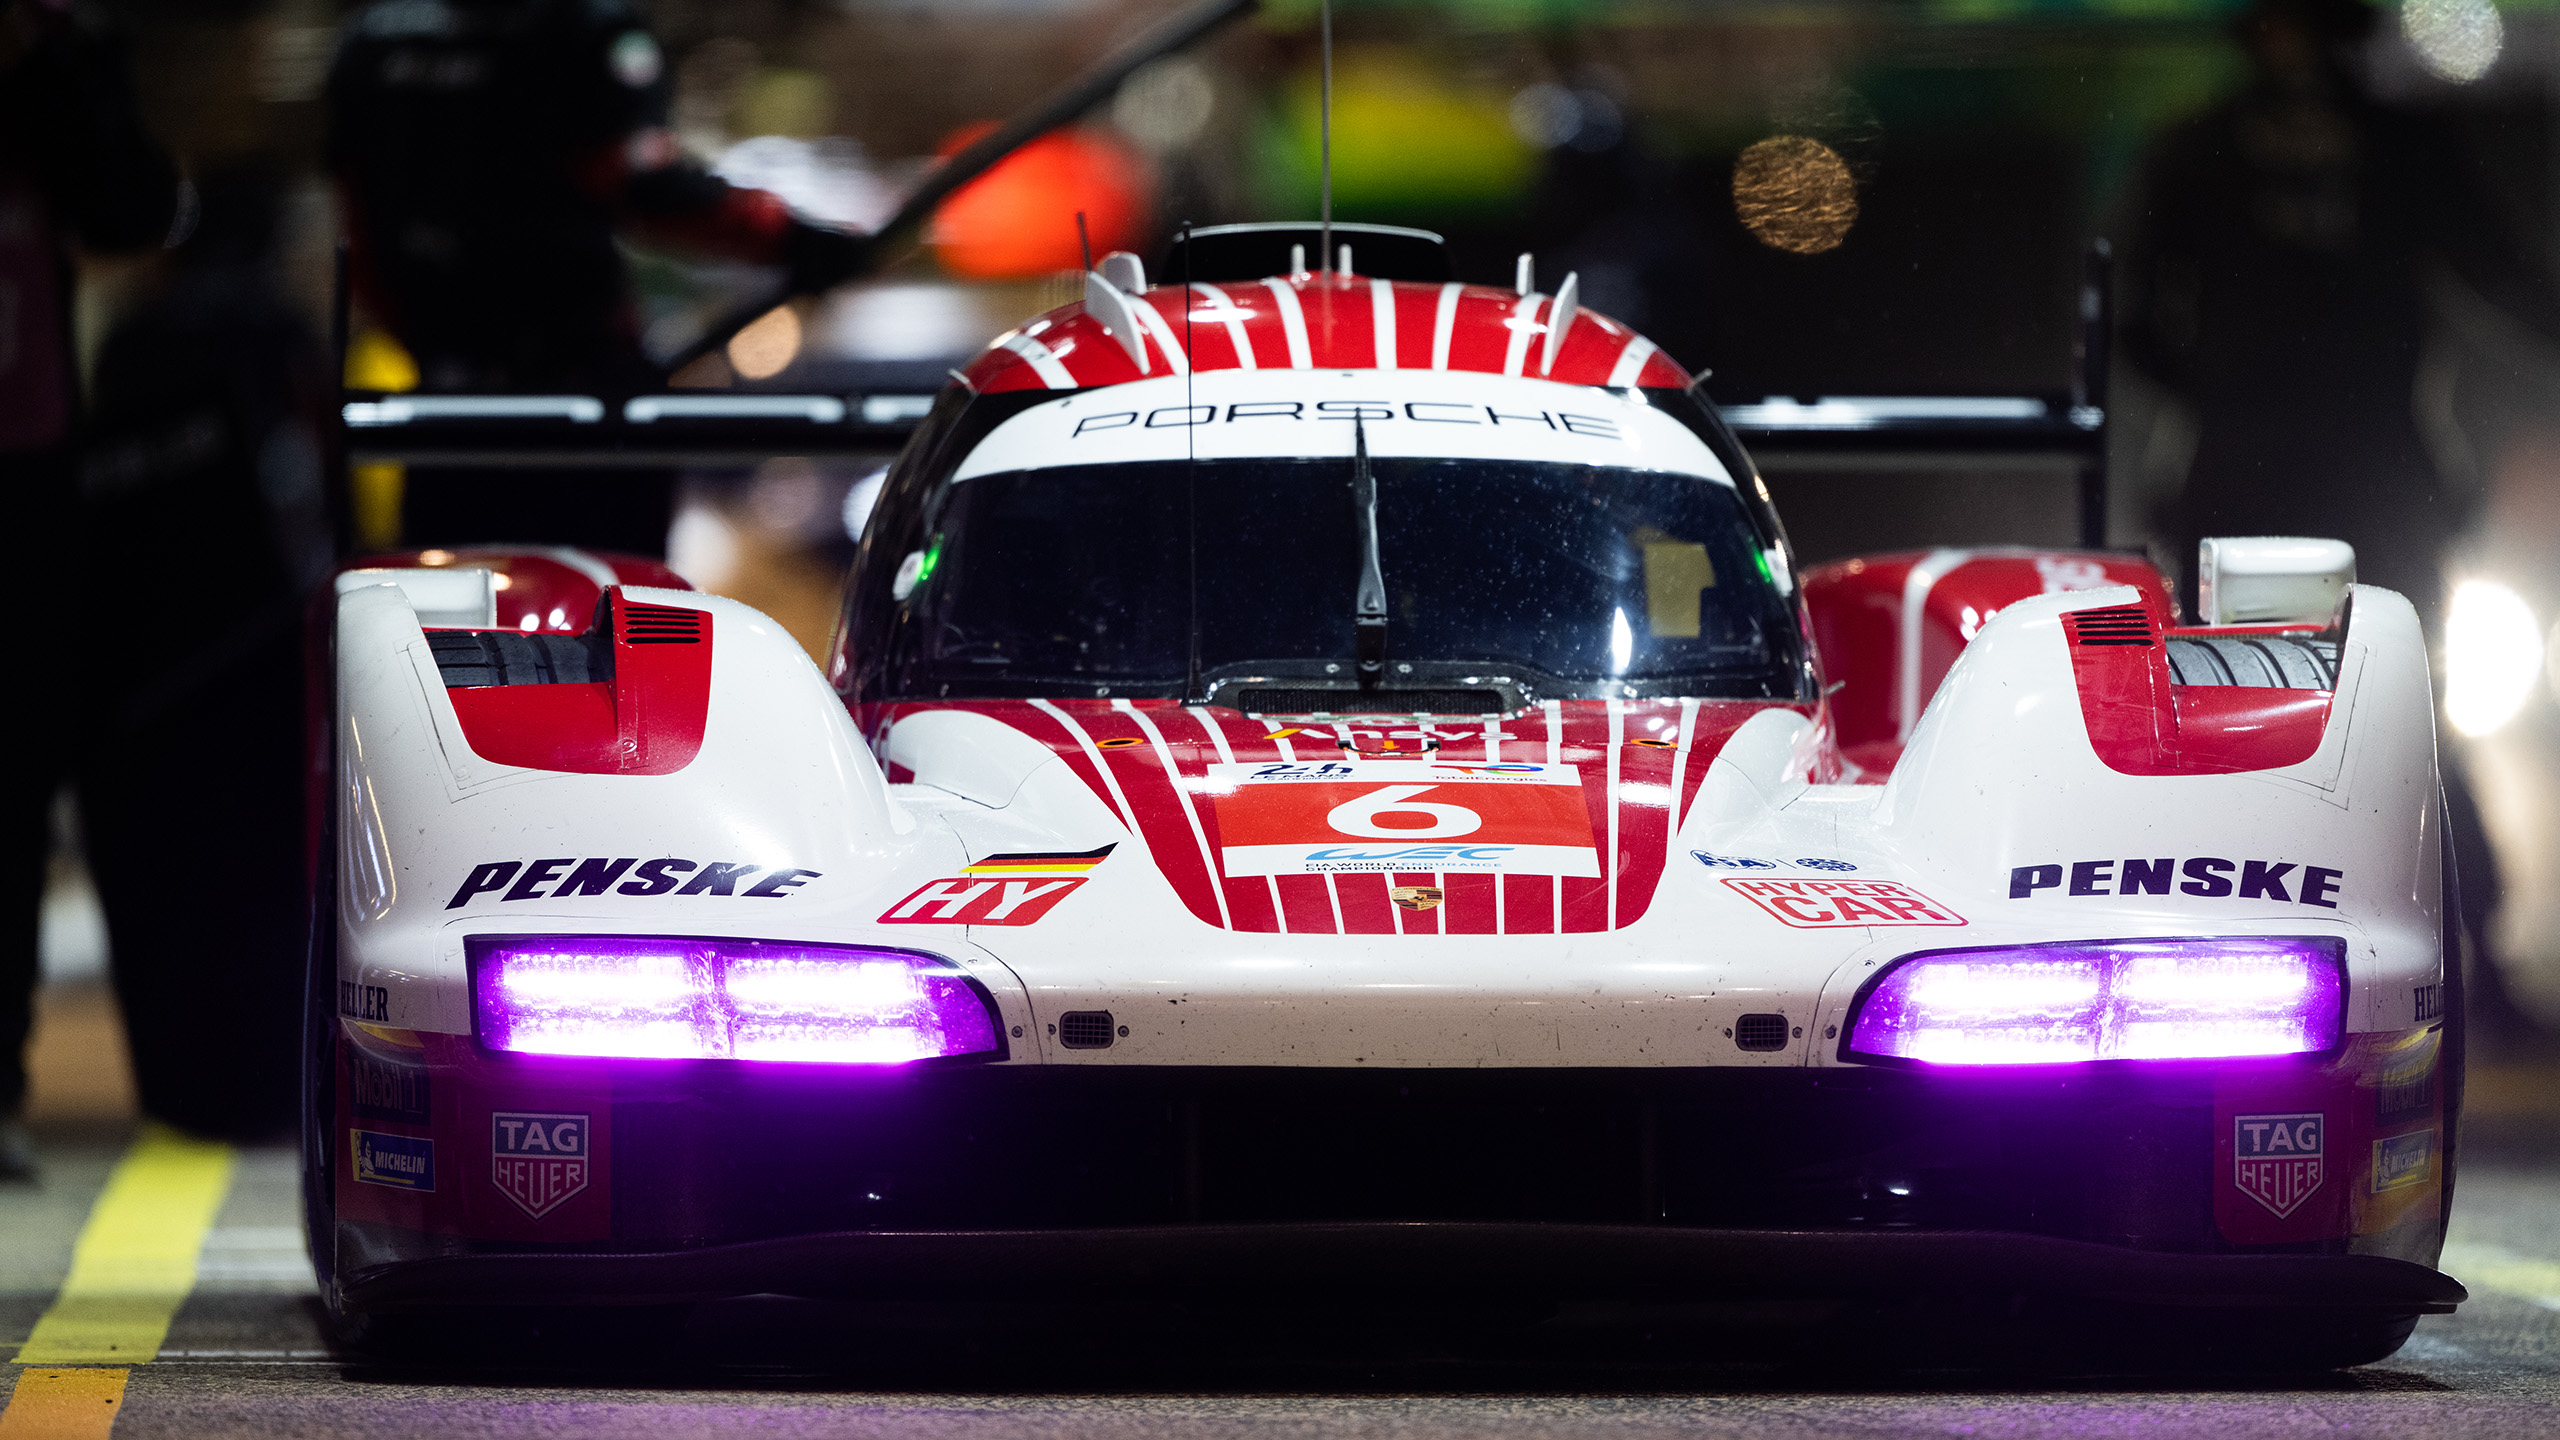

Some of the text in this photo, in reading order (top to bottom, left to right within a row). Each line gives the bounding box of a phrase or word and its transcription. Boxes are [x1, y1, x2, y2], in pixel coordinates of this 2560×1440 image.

[1072, 400, 1621, 440] PORSCHE
[1326, 784, 1483, 840] 6
[1305, 846, 1516, 861] WEC
[444, 857, 824, 910] PENSKE
[889, 881, 1078, 920] HY
[1737, 882, 1912, 897] HYPER
[2008, 857, 2344, 909] PENSKE
[1769, 896, 1951, 923] CAR
[340, 979, 390, 1023] HELLER
[353, 1057, 404, 1112] Mobil
[499, 1120, 579, 1152] TAG
[2243, 1120, 2317, 1152] TAG
[375, 1150, 426, 1175] MICHELIN
[2390, 1147, 2426, 1174] MICHELIN
[497, 1160, 581, 1209] HEUER
[2241, 1161, 2318, 1210] HEUER
